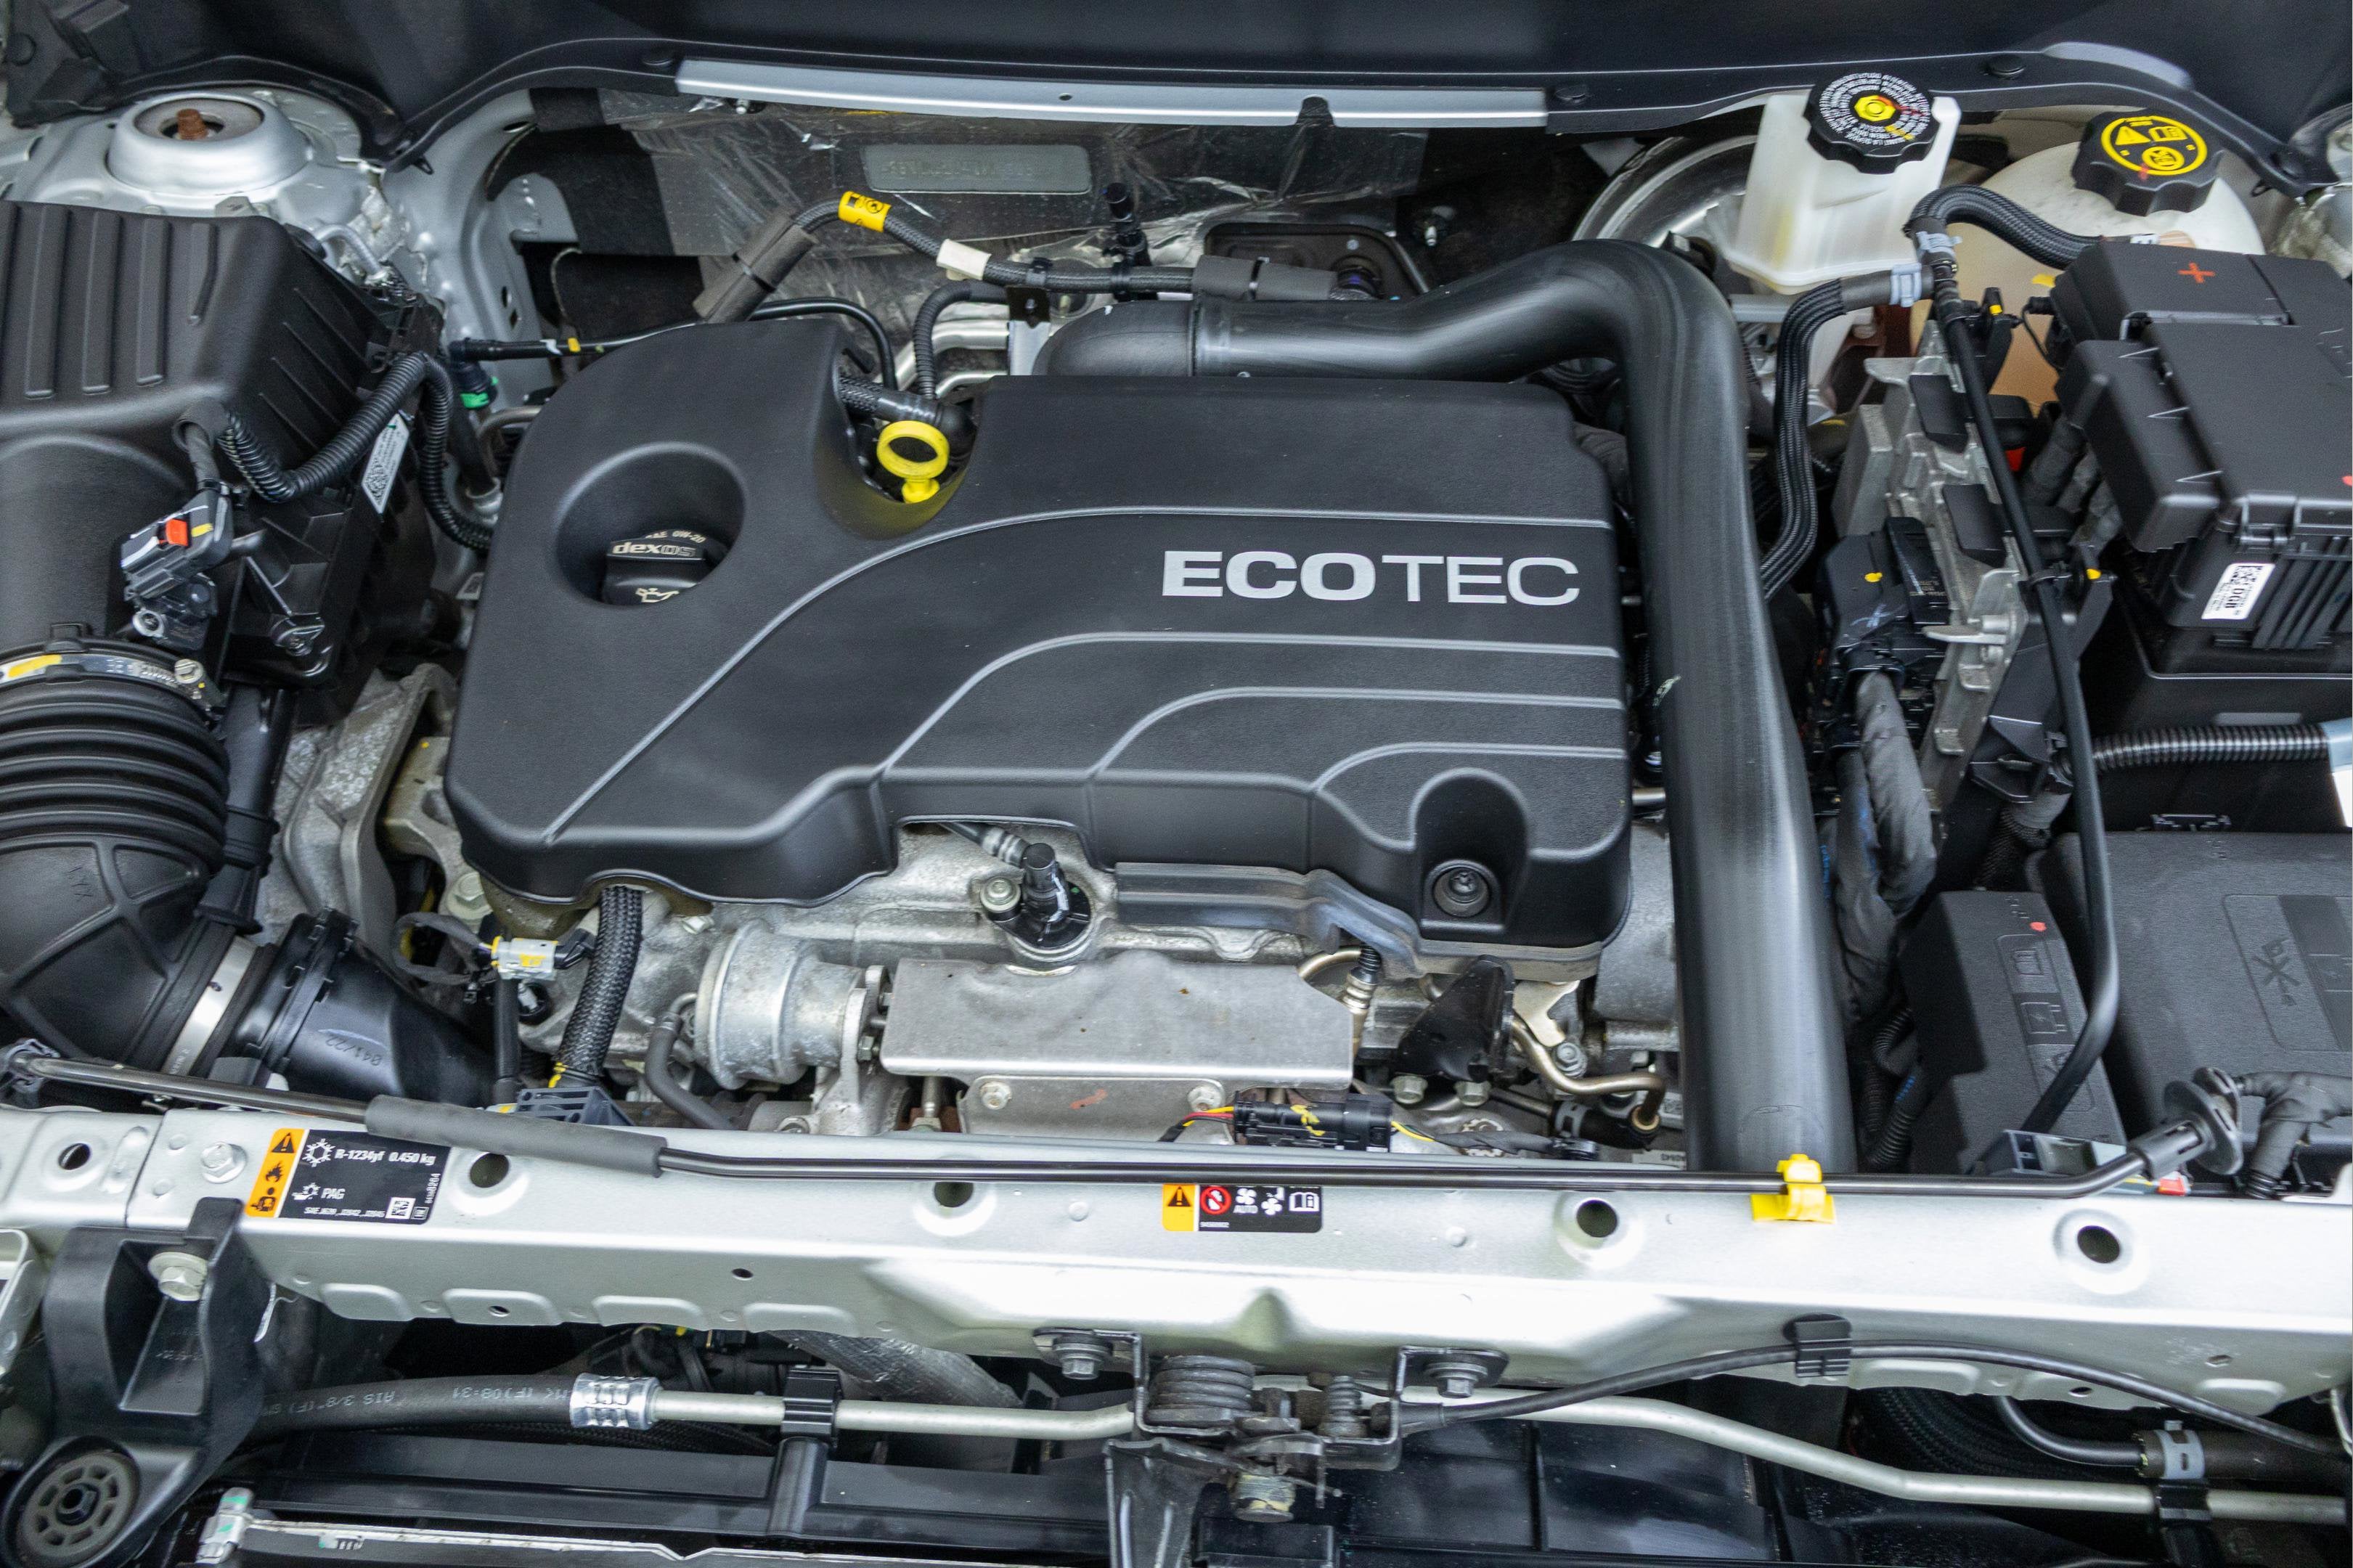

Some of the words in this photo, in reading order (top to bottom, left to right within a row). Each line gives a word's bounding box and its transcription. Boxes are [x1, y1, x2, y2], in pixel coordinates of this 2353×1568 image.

[612, 542, 697, 558] dexos
[1162, 550, 1581, 606] ECOTEC
[335, 1148, 386, 1163] R-1234yf
[388, 1151, 421, 1163] 0.450
[420, 1153, 436, 1166] kg
[321, 1188, 346, 1200] PAG
